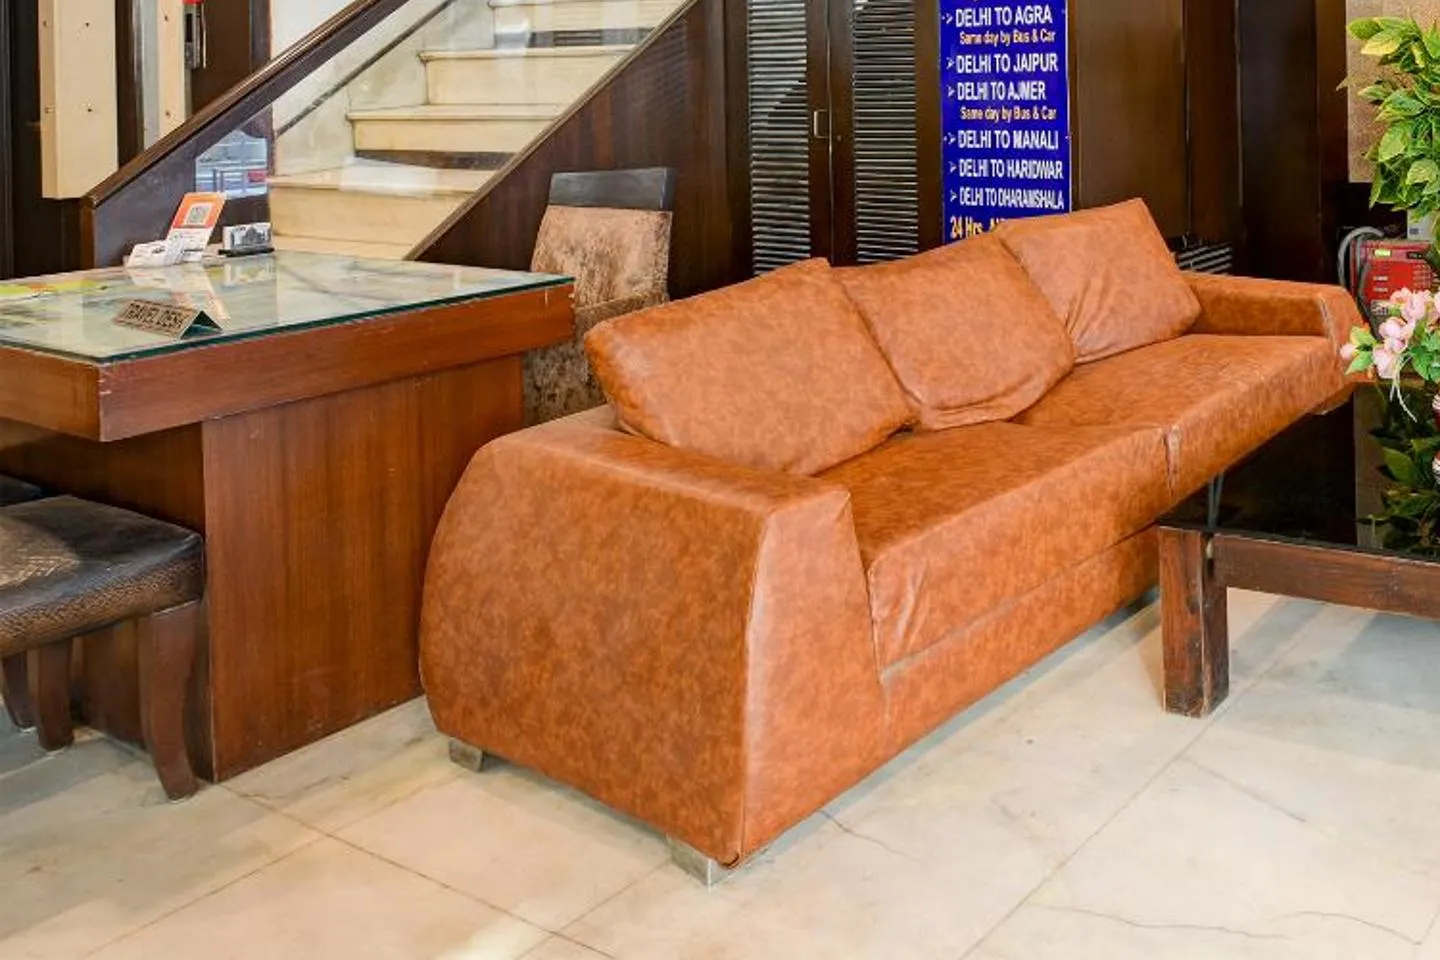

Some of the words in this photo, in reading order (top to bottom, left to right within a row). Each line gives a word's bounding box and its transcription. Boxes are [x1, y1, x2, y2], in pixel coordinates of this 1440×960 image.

[955, 7, 991, 28] DELHI
[994, 6, 1012, 25] TO
[1015, 4, 1053, 25] AGRA
[960, 30, 982, 45] Same
[984, 30, 999, 47] day
[1000, 30, 1011, 47] by
[1013, 29, 1029, 43] Bus
[1031, 28, 1038, 42] &
[1040, 28, 1056, 42] Car
[956, 55, 992, 74] DELHI
[994, 53, 1011, 73] TO
[1013, 53, 1059, 72] JAIPUR
[957, 81, 990, 100] DELHI
[990, 81, 1006, 100] TO
[1008, 80, 1046, 100] AJMER
[960, 106, 983, 120] Same
[985, 106, 999, 123] day
[1001, 105, 1012, 123] by
[1013, 106, 1031, 120] Bus
[1032, 105, 1039, 119] &
[1042, 106, 1057, 119] Car
[958, 130, 992, 149] DELHI
[994, 130, 1011, 148] TO
[1013, 129, 1059, 150] MANALI
[959, 158, 989, 177] DELHI
[990, 158, 1005, 177] TO
[1007, 158, 1064, 179] HARIDWAR
[960, 186, 984, 206] DELHI
[985, 187, 997, 206] TO
[998, 187, 1065, 210] DHARAMSHALA
[950, 216, 963, 239] 24
